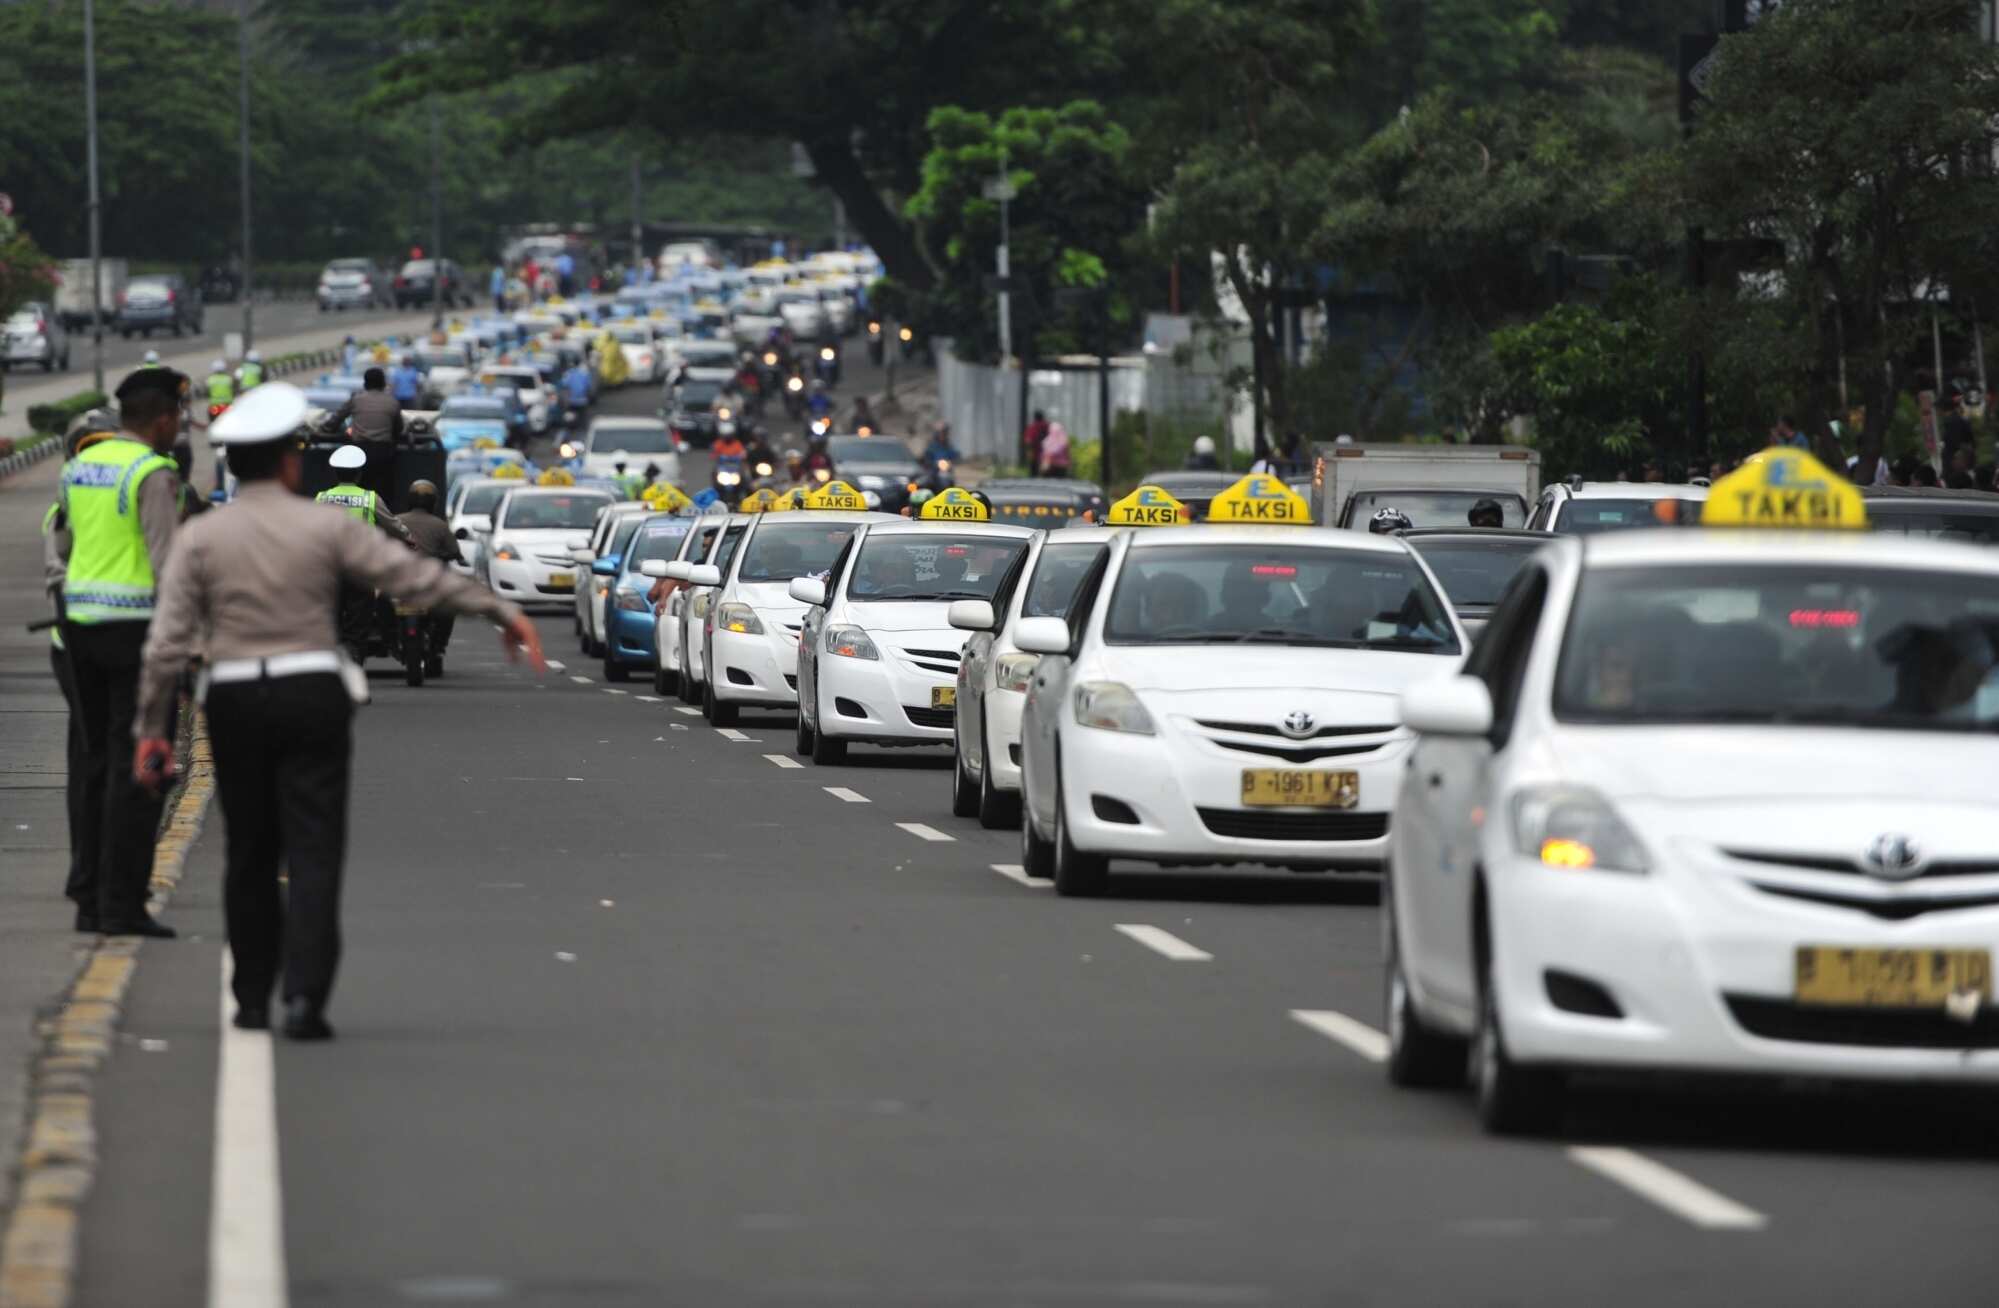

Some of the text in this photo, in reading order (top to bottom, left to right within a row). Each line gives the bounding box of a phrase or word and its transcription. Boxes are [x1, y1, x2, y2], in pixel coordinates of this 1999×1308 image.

[818, 496, 857, 507] TAKSI
[1736, 493, 1842, 519] TAKSI
[934, 506, 978, 518] TAKSI
[1123, 508, 1178, 523] TAKSI
[1228, 501, 1294, 518] TAKSI
